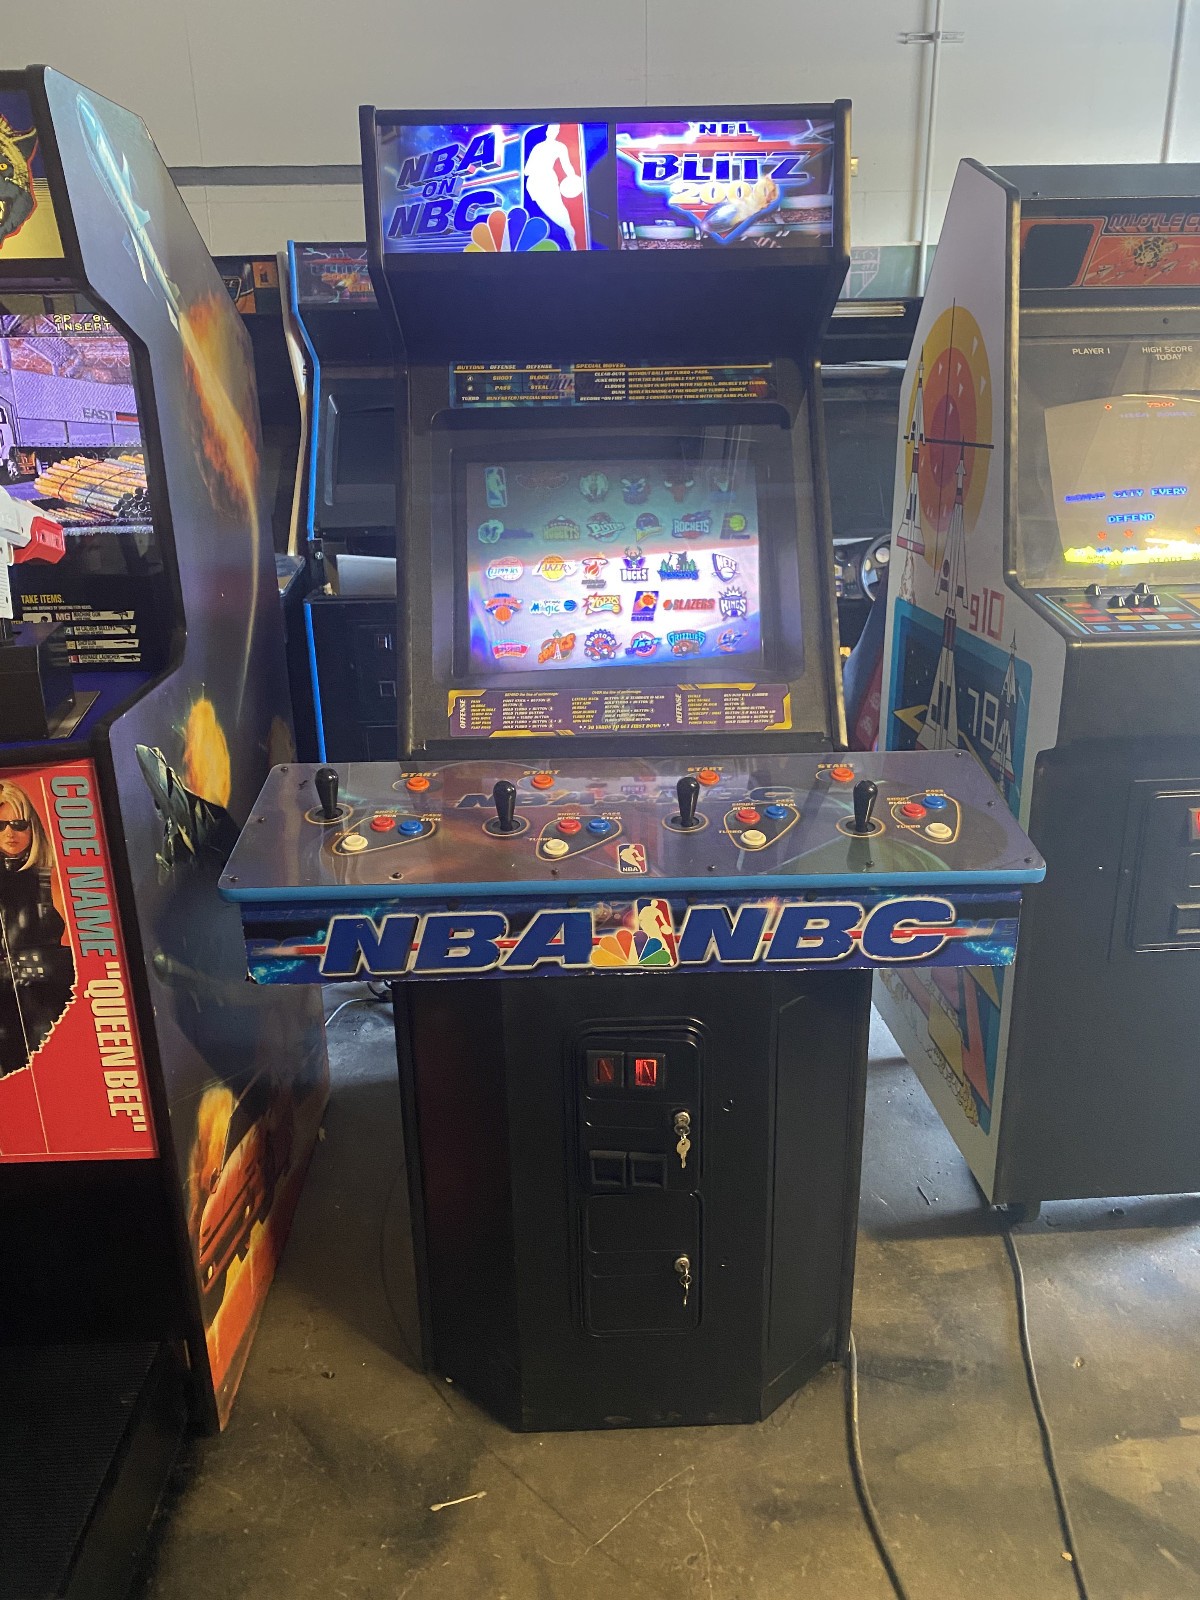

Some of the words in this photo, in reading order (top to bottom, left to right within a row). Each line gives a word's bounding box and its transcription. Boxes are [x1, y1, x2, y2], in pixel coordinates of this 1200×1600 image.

[698, 121, 754, 135] NFL
[397, 131, 501, 189] NBA
[639, 151, 812, 182] BLITZ
[422, 177, 462, 199] ON
[669, 180, 780, 206] 2000
[387, 191, 502, 239] NBC
[1108, 213, 1186, 232] MISSILE
[54, 314, 71, 323] 2P
[56, 322, 111, 331] INSERT
[1072, 347, 1105, 355] PLAYER
[1164, 345, 1193, 353] SCORE
[1155, 353, 1182, 361] TODAY
[82, 407, 115, 421] EAST
[1150, 486, 1188, 496] EVERY
[1107, 512, 1156, 524] DEFEND
[673, 519, 711, 533] ROCKETS
[21, 594, 39, 604] TAKE
[40, 594, 65, 604] ITEMS.
[672, 598, 716, 610] BLAZERS
[720, 600, 747, 615] KINGS
[55, 612, 71, 621] MG
[668, 631, 706, 645] GRIZZLIES
[459, 698, 467, 729] OFFENSE
[50, 776, 100, 858] CODE
[66, 866, 118, 957] NAME
[320, 909, 599, 976] NBA
[676, 895, 957, 965] NBC
[83, 961, 132, 1067] "QUEEN
[102, 1071, 148, 1133] BEE"
